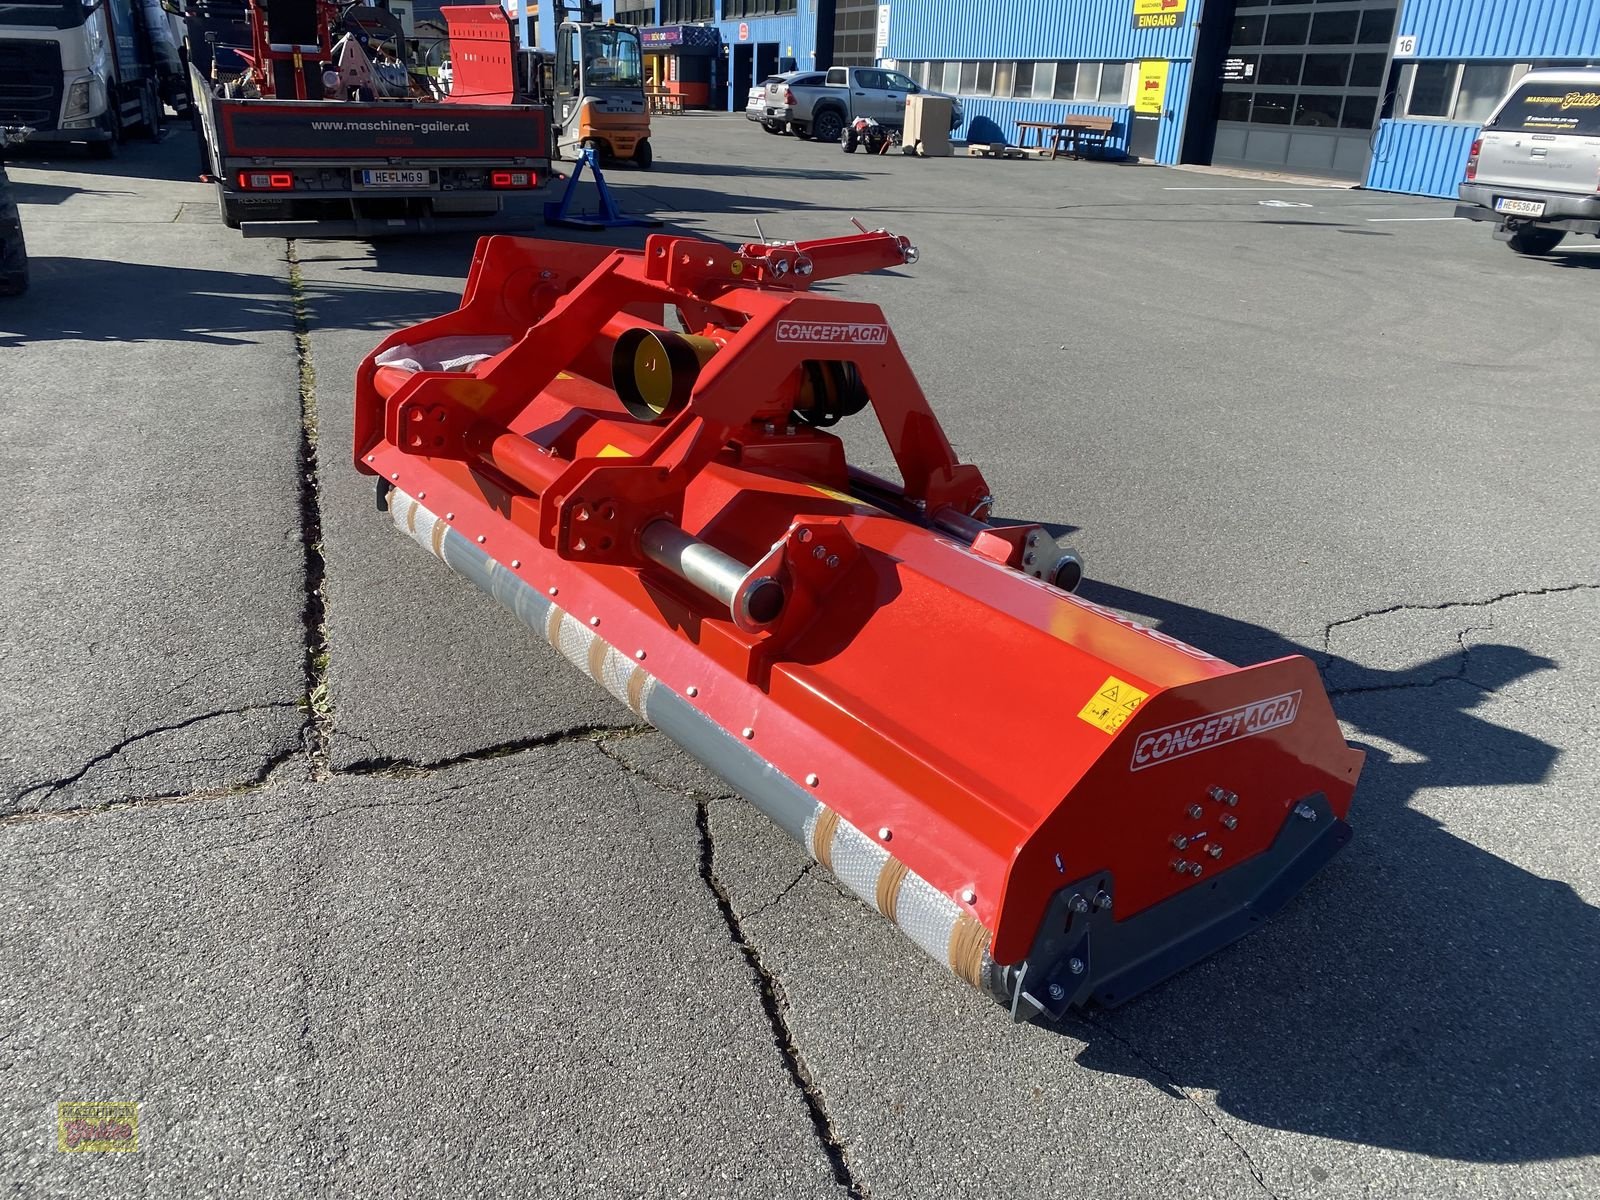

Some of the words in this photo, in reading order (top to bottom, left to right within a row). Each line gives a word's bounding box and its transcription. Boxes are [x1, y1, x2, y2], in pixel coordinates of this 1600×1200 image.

[1138, 14, 1177, 27] EINGANG
[1400, 39, 1413, 52] 16
[311, 120, 470, 134] www.maschinen-gailer.at
[375, 171, 388, 183] HE
[395, 171, 415, 183] LMG
[416, 171, 423, 183] 9
[1503, 200, 1512, 209] HE
[1516, 202, 1531, 212] 536
[1530, 204, 1542, 213] AP
[779, 323, 887, 342] CONCEPTAGRI
[1135, 695, 1297, 764] CONCEPTAGRI
